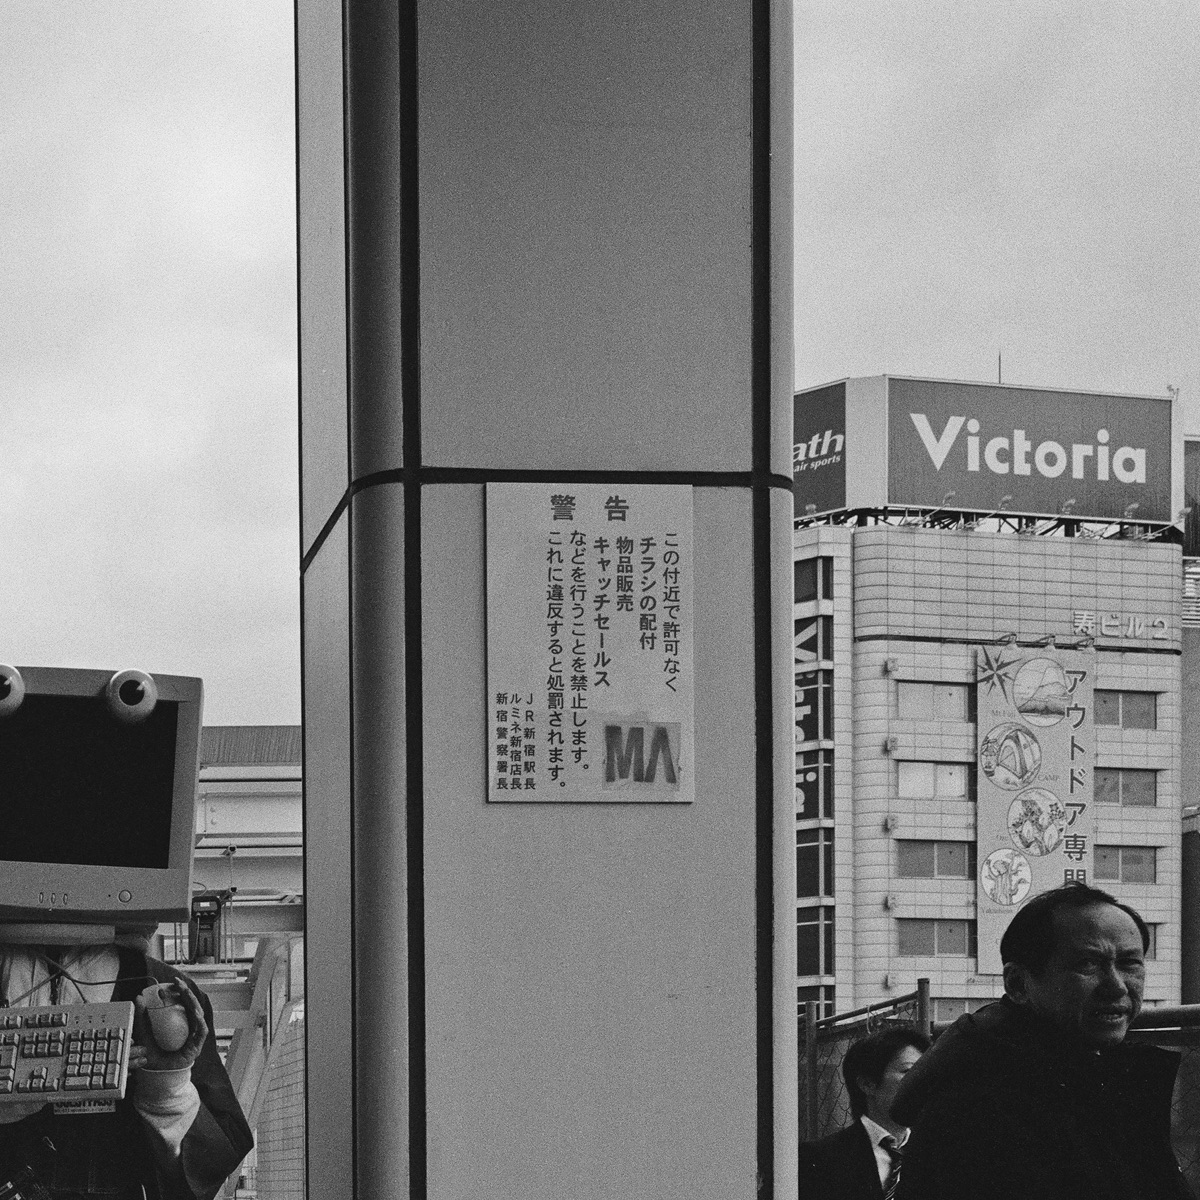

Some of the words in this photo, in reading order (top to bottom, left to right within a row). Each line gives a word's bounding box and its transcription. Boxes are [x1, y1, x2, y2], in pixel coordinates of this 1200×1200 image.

[810, 455, 841, 470] sports
[910, 412, 1147, 484] Victoria
[551, 494, 629, 521] 警告
[593, 536, 611, 687] キャッチセールス
[616, 536, 634, 612] 物品販売
[639, 536, 657, 650] チラシの配付
[663, 532, 681, 692] この付近で許可なく
[546, 530, 566, 788] これに違反すると処罰されます。
[570, 530, 589, 770] などを行うことを禁止します。
[496, 693, 509, 790] 新宿警察署長
[510, 693, 522, 790] ルミネ新宿店長
[524, 693, 536, 790] JR新宿駅長
